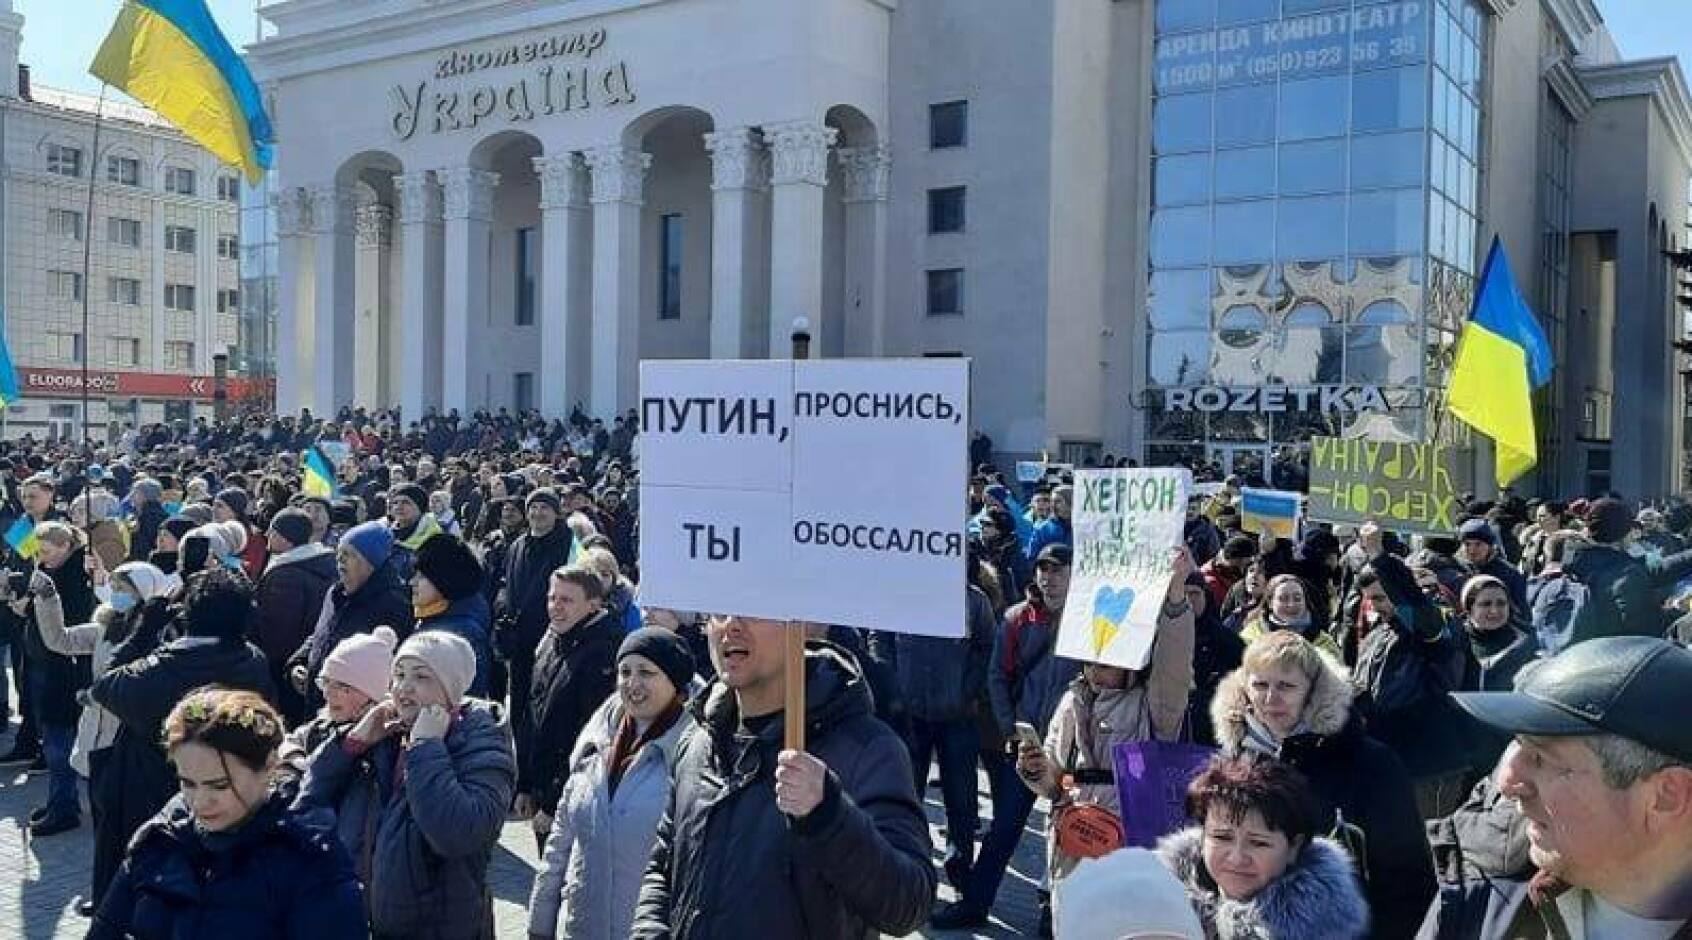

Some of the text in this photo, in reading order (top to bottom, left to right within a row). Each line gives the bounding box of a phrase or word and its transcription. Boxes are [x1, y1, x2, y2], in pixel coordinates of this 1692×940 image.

[1158, 3, 1421, 61] АРЕНДА КИНОТЕАТР
[29, 373, 103, 388] ELDORADO
[1165, 385, 1390, 412] ROZETKA
[641, 392, 963, 444] ПУТИН, ПРОСНИСЬ,
[1082, 477, 1177, 514] ХЕРСОН
[682, 520, 963, 563] ТЫ ОБОССАЛСЯ
[1109, 516, 1138, 546] ЦЕ
